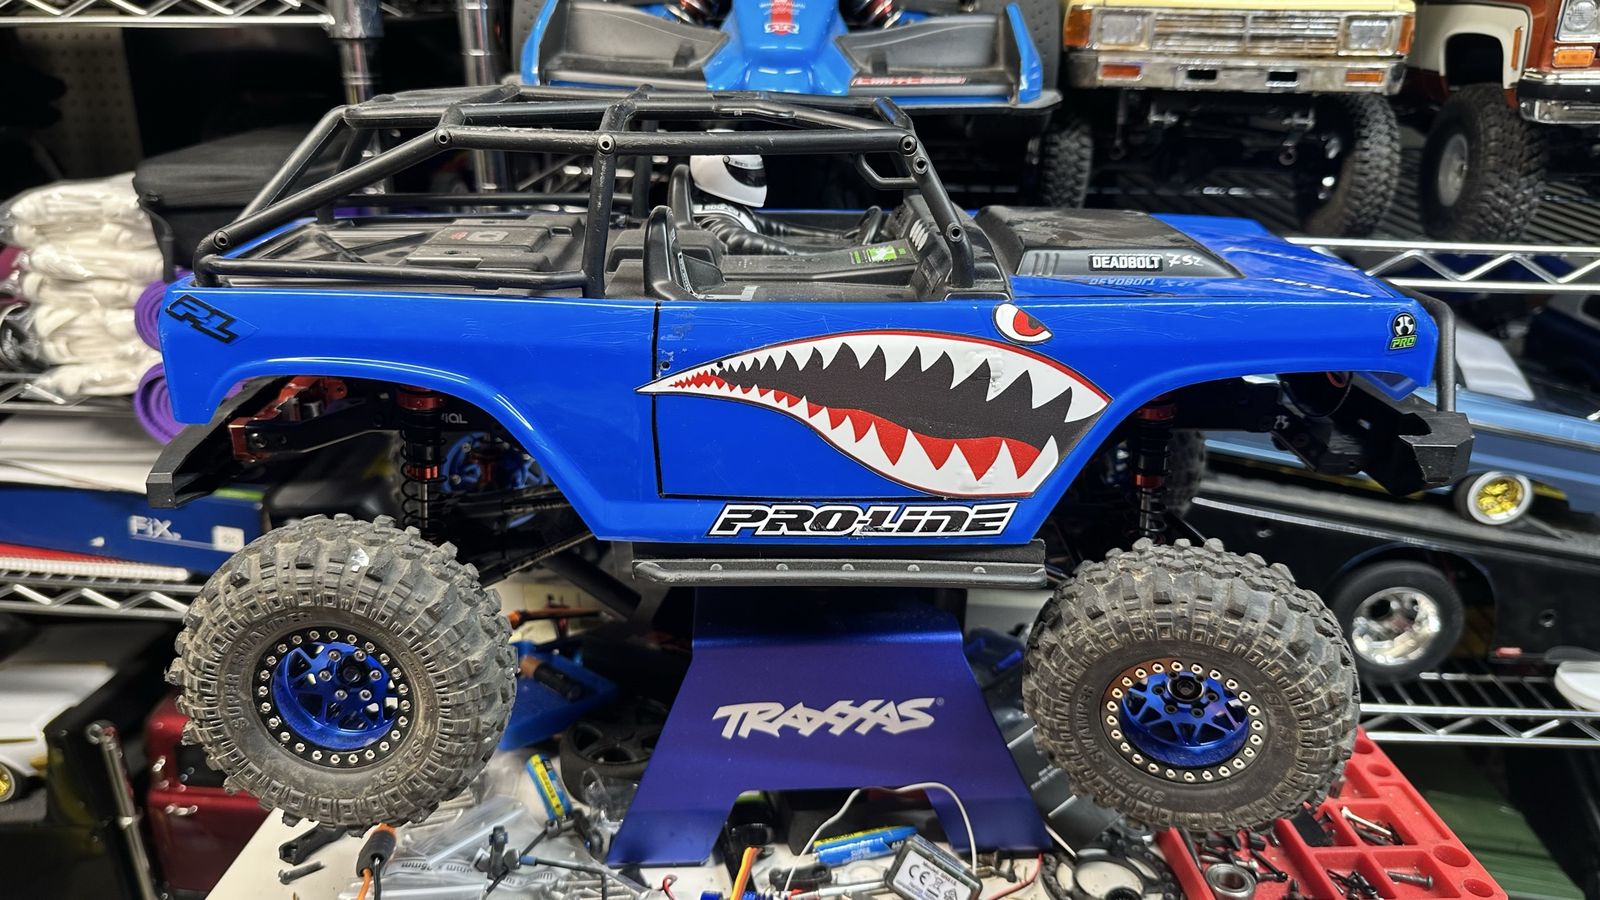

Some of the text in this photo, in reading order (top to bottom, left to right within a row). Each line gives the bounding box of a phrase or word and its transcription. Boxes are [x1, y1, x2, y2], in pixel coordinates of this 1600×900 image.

[1092, 256, 1161, 269] DEADBOLT
[1391, 336, 1416, 348] PRO
[712, 697, 935, 740] TRAXXAS
